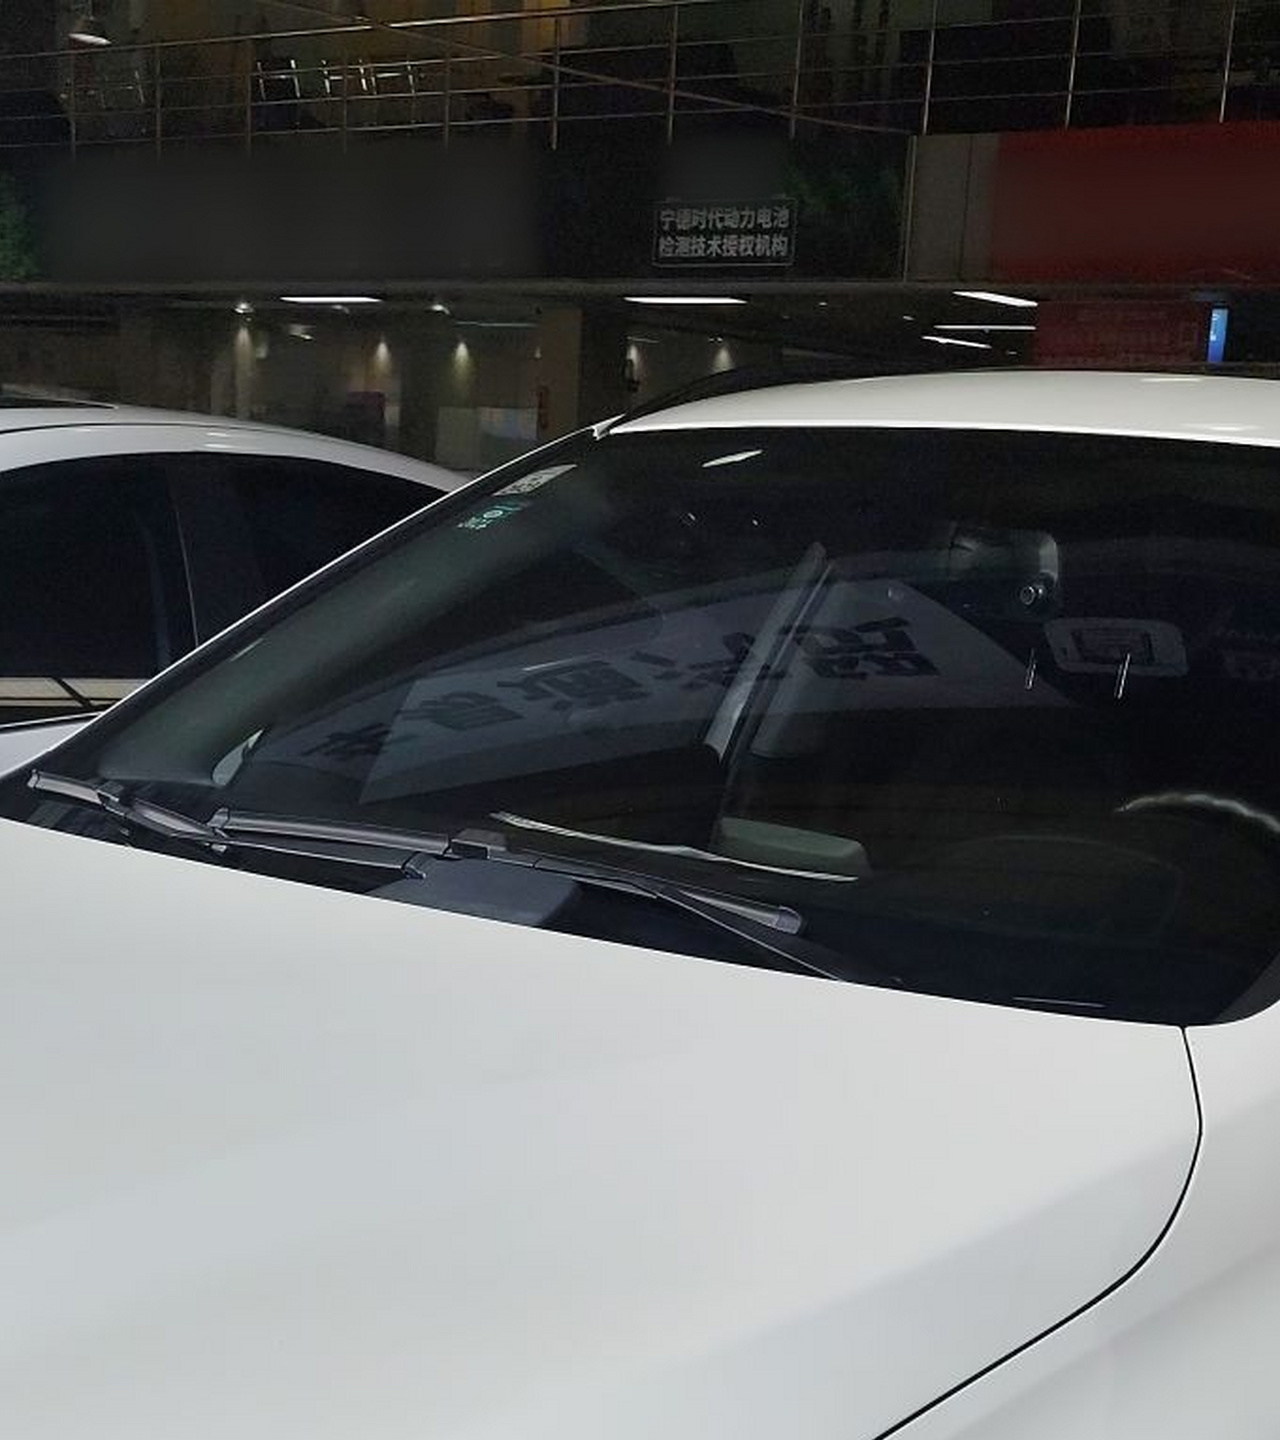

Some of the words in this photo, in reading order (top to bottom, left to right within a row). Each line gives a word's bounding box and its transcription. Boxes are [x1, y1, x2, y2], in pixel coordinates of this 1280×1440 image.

[660, 206, 790, 230] 宁德时代动力电池
[660, 233, 789, 257] 检测技术授权机构
